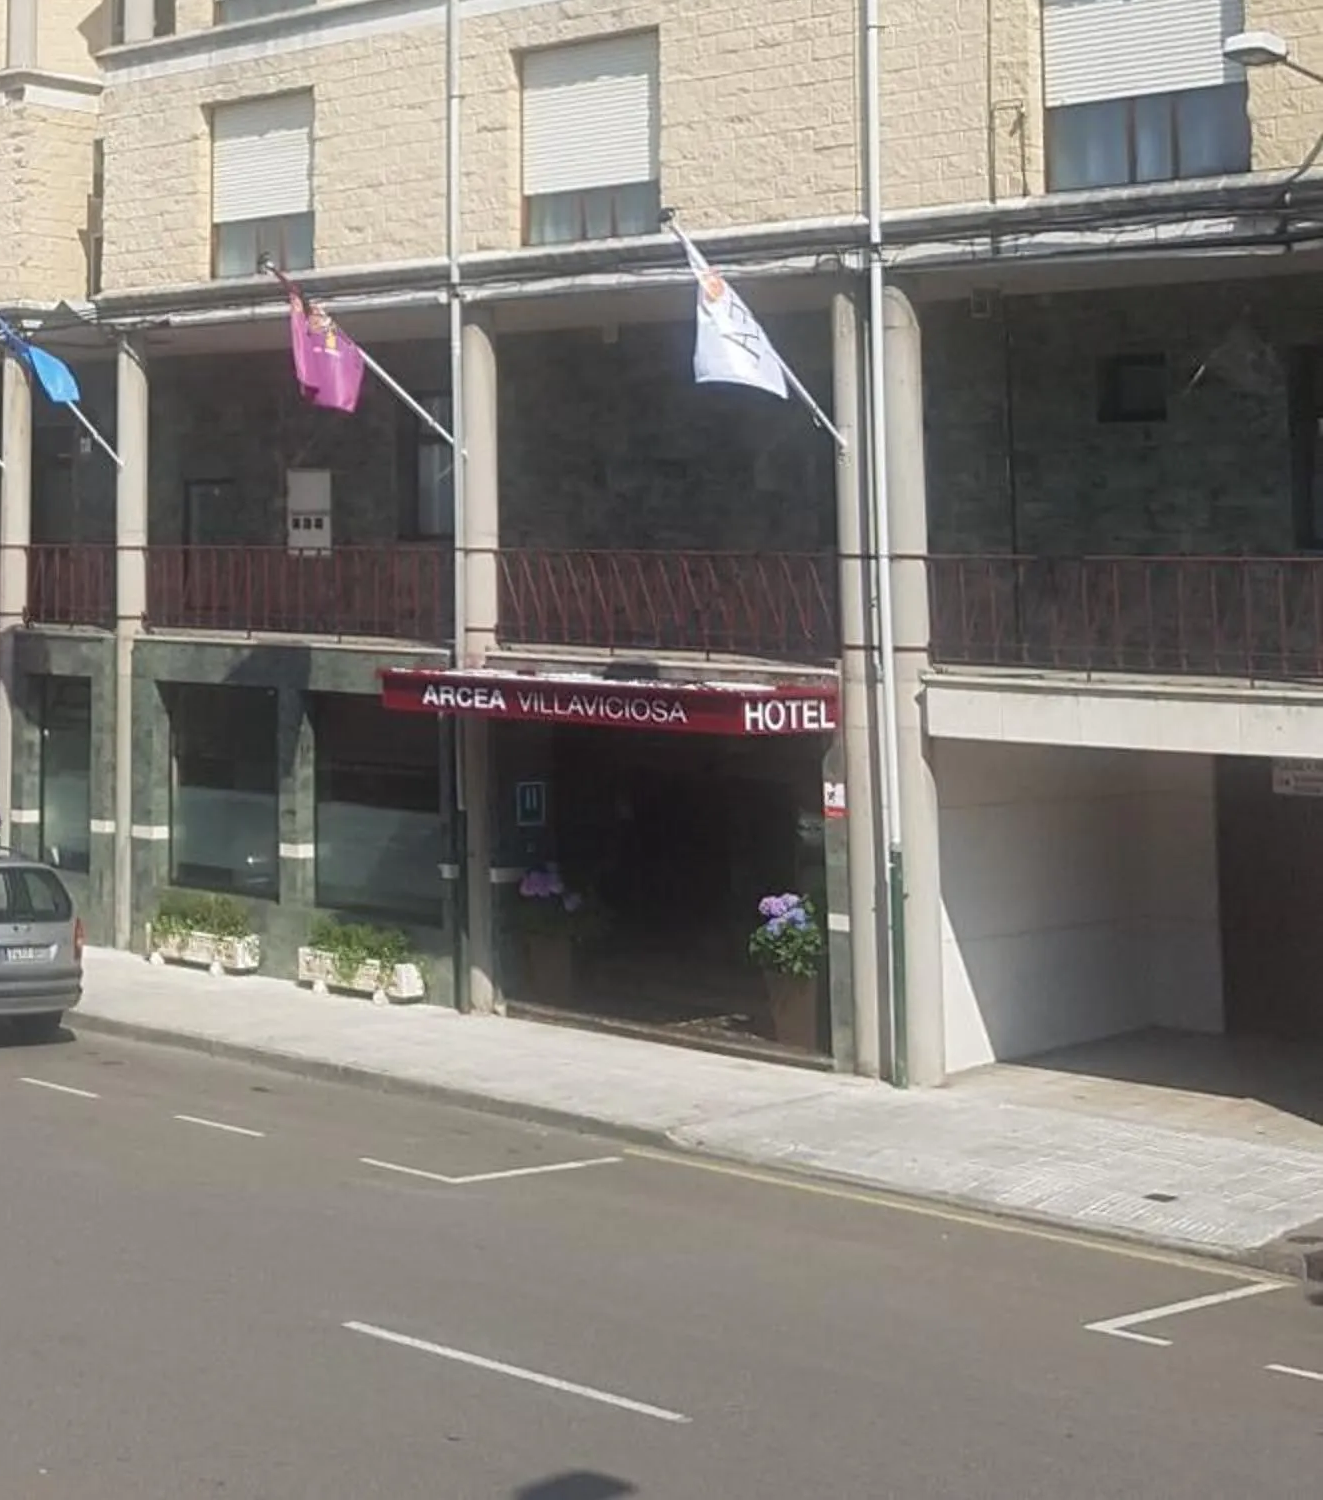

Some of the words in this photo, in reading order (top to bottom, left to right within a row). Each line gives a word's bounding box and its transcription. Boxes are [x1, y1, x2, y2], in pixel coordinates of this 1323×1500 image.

[423, 684, 506, 710] ARCEA
[517, 690, 688, 723] VILLAVICIOSA
[744, 699, 836, 731] HOTEL
